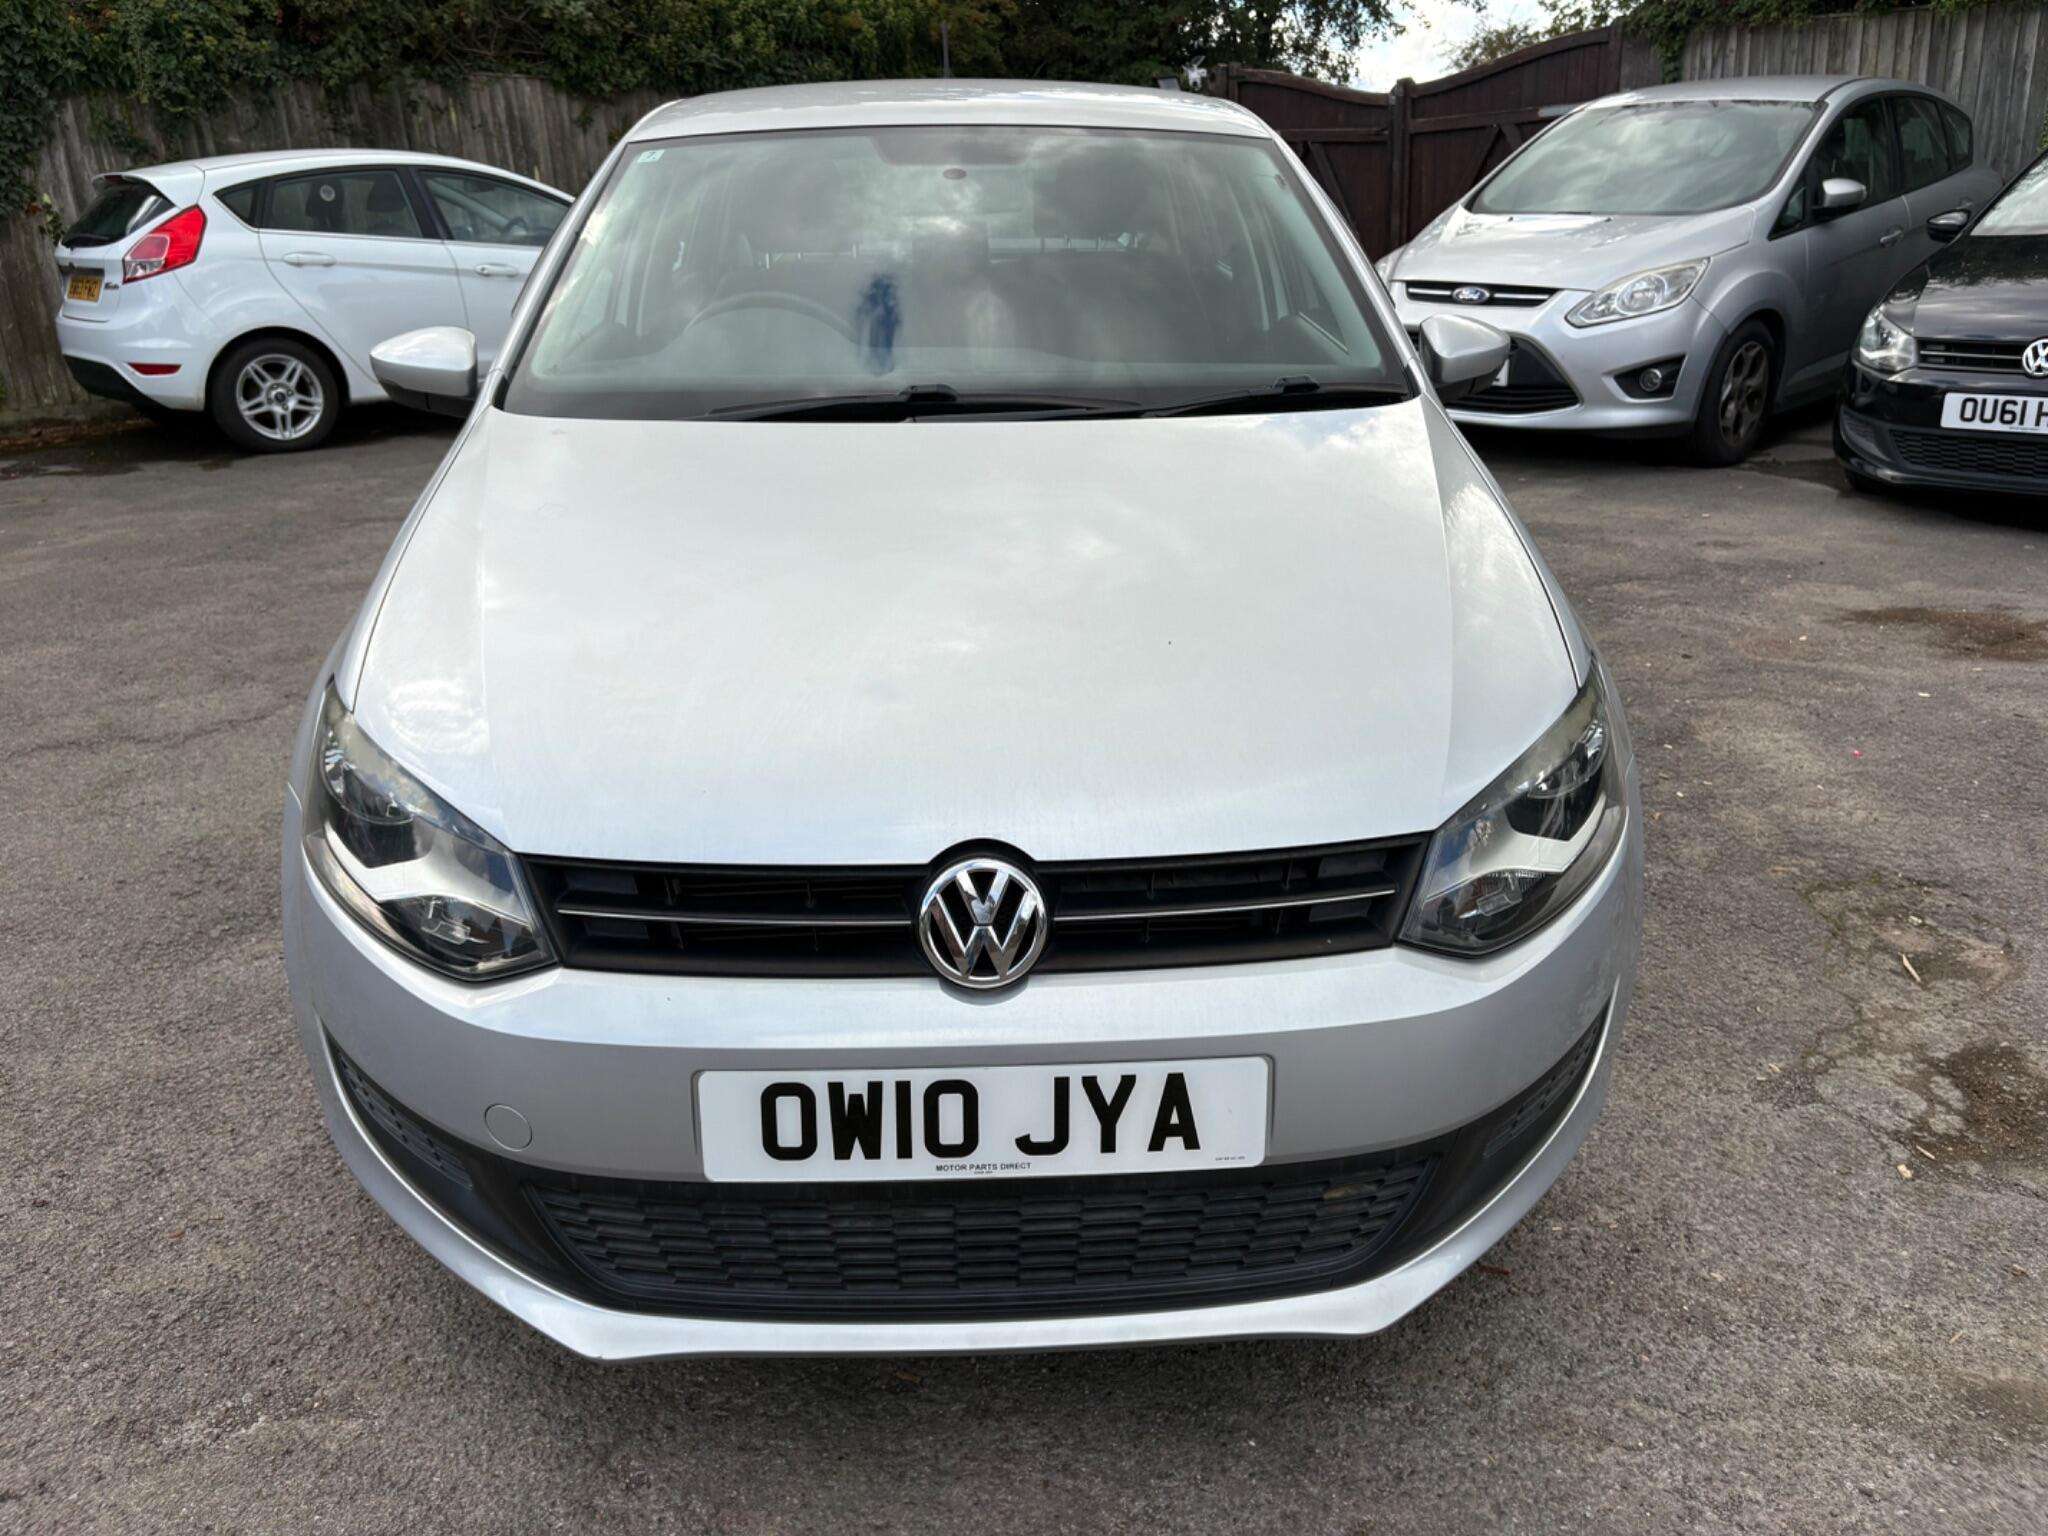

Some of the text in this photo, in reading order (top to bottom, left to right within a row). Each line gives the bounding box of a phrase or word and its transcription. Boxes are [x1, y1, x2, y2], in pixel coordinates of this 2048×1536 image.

[1959, 397, 2028, 426] OU61
[759, 1072, 1201, 1161] OW10 JYA
[936, 1164, 967, 1172] MOTOR
[969, 1163, 998, 1171] PARTS
[1000, 1162, 1032, 1170] DIRECT
